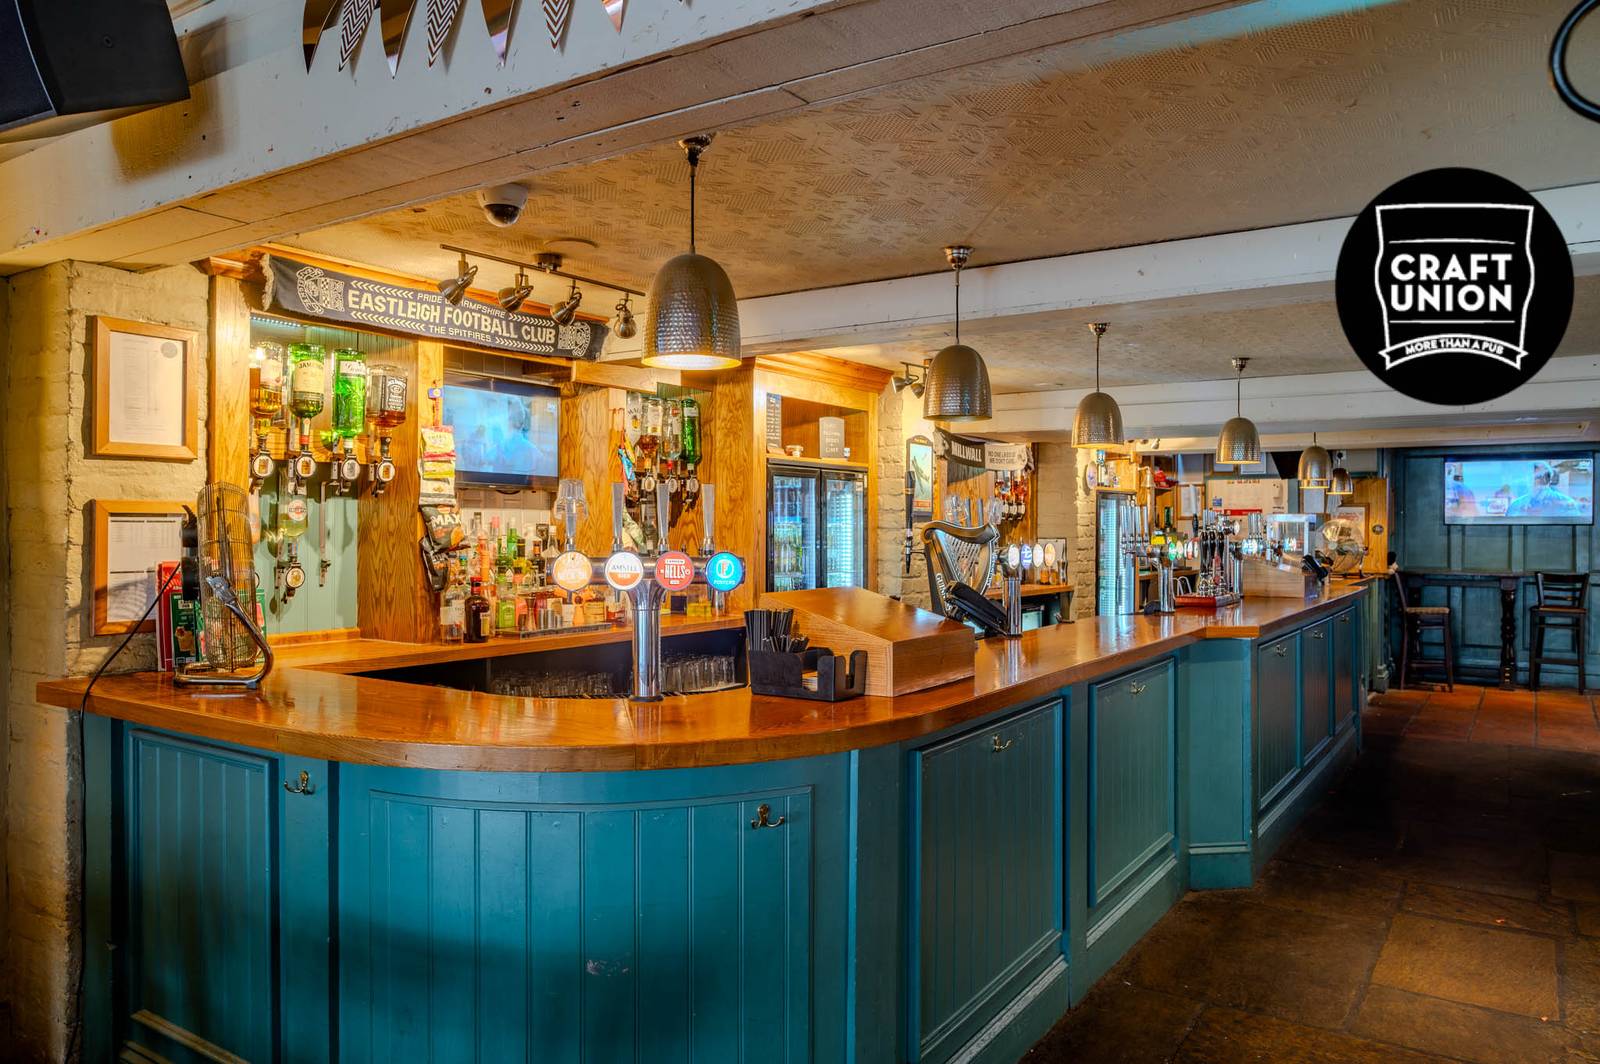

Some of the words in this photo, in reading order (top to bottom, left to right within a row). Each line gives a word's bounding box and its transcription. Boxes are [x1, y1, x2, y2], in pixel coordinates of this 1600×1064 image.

[417, 292, 443, 304] PRIDE
[347, 289, 440, 323] EASTLEIGH
[444, 307, 518, 339] FOOTBALL
[521, 325, 556, 344] CLUB
[428, 325, 446, 335] THE
[448, 327, 492, 343] SPITFIRES
[951, 441, 982, 462] MILLWALL
[664, 564, 686, 579] HELLS
